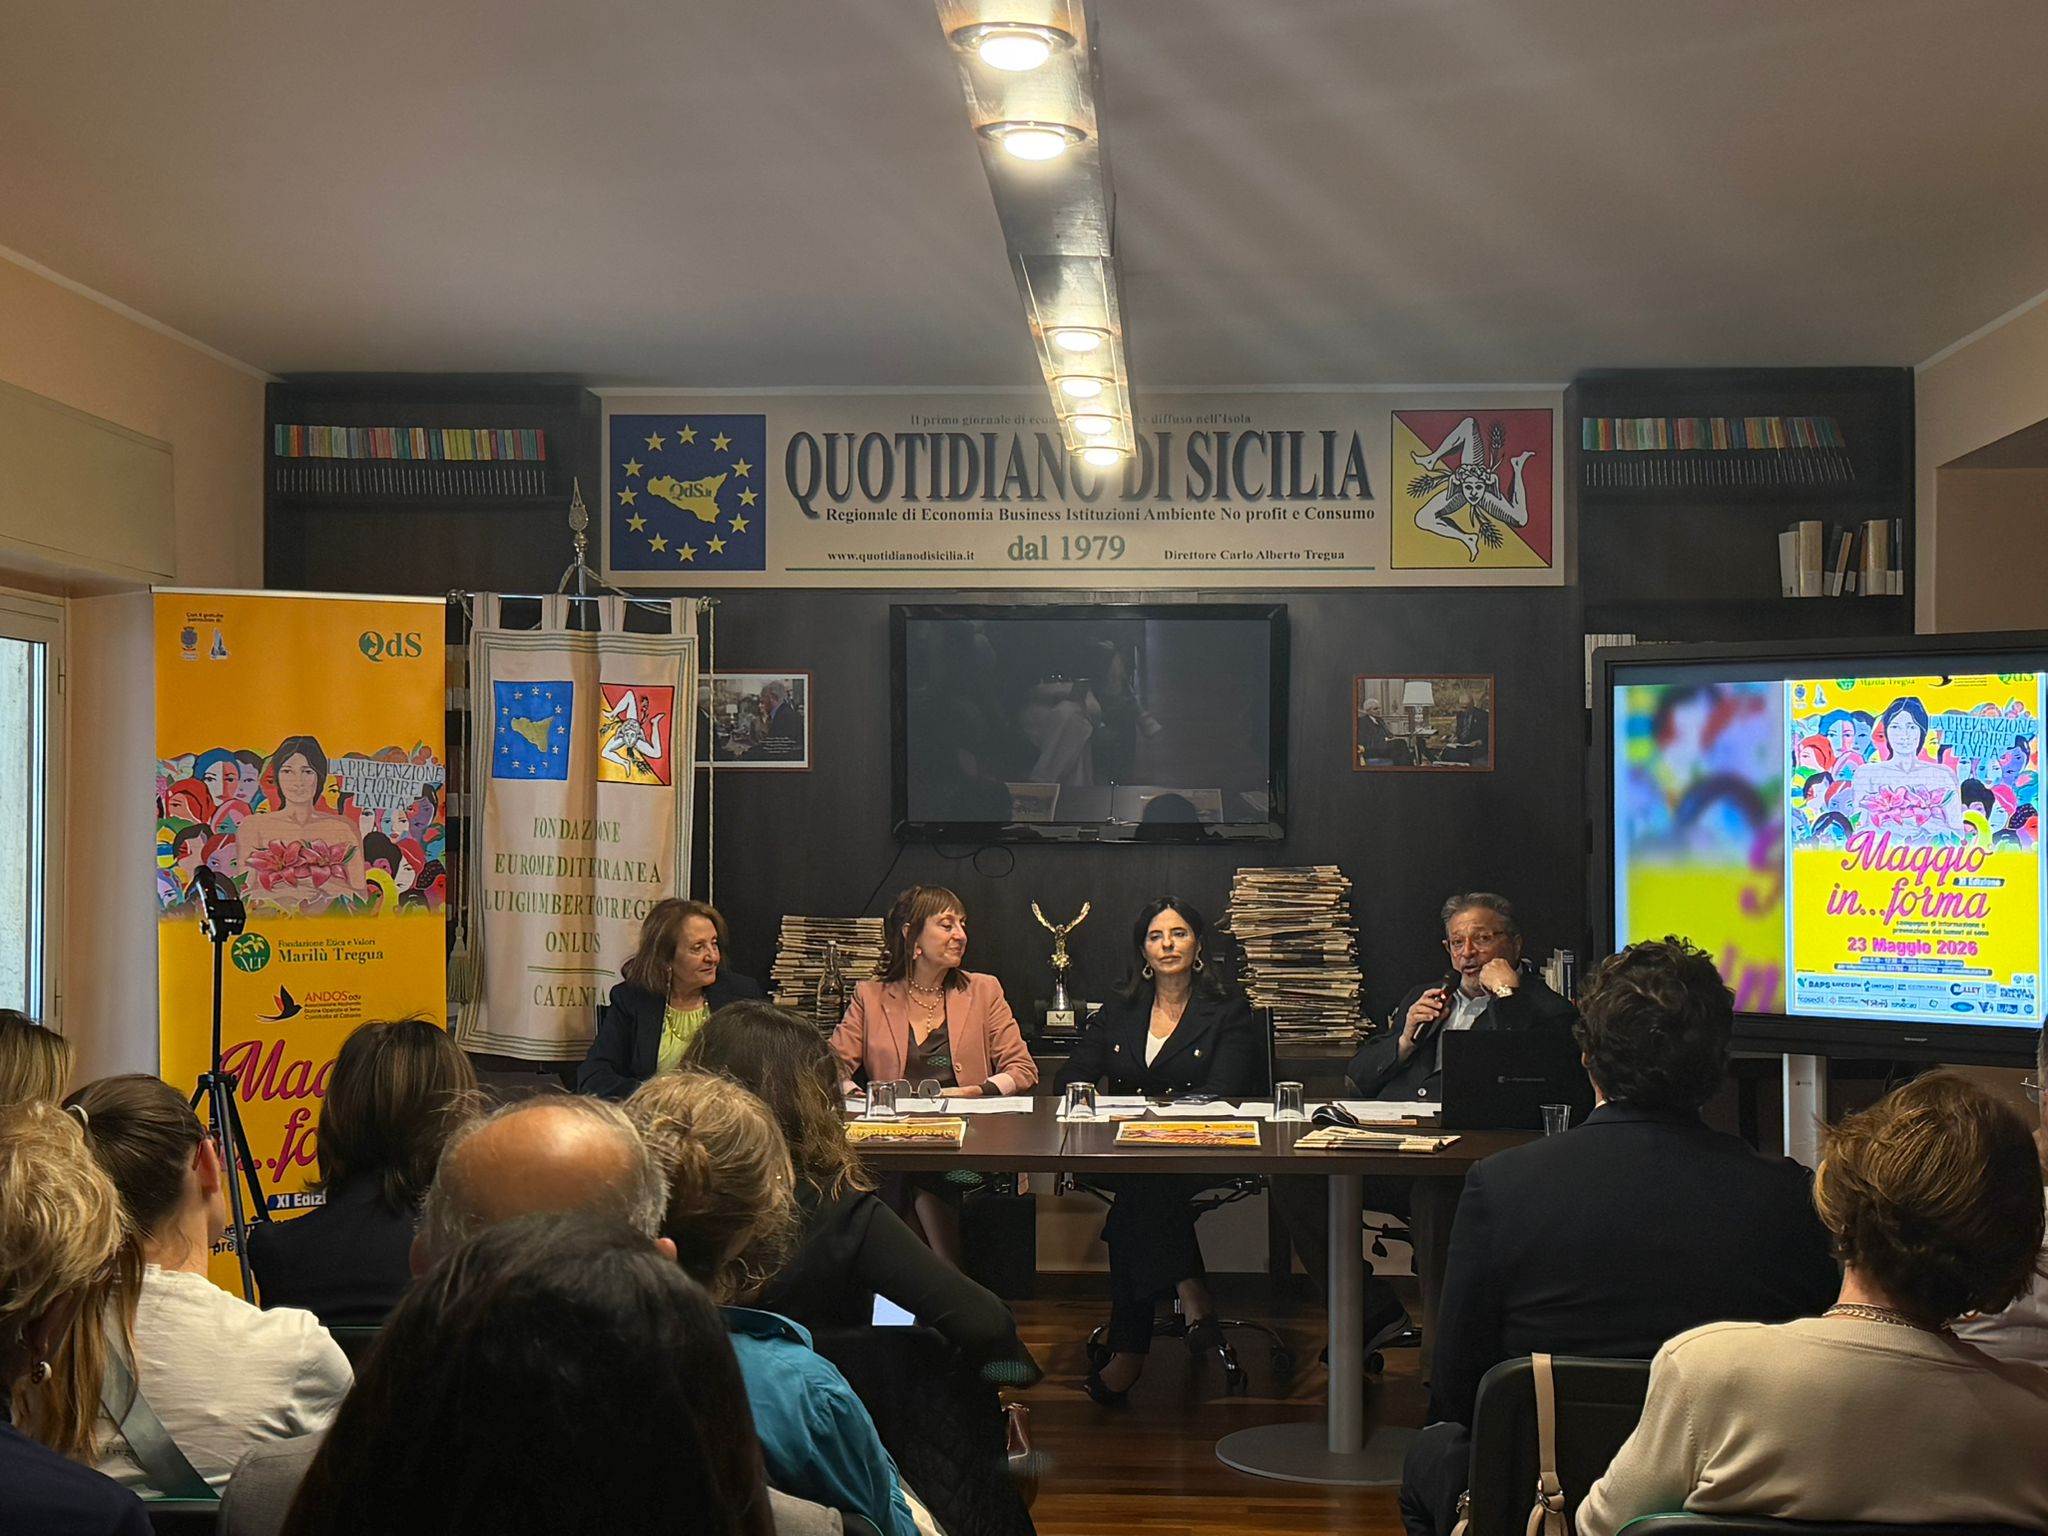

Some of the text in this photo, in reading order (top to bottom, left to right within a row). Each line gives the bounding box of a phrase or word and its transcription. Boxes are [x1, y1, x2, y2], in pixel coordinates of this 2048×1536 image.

[923, 415, 959, 427] primo
[962, 415, 1010, 426] giornale
[1014, 415, 1025, 425] di
[1152, 413, 1192, 424] diffuso
[1119, 431, 1173, 503] DI
[1186, 430, 1375, 503] SICILIA
[826, 507, 1375, 523] Regionale di Economia Business Istituzioni Ambiente No profit e Consumo
[827, 550, 974, 562] www.quotidianodisicilia.it
[1007, 535, 1126, 561] dal 1979
[1164, 550, 1345, 561] Direttore Carlo Alberto Tregua
[359, 631, 422, 662] QdS
[1947, 716, 2033, 734] PREVENZIONE
[348, 761, 443, 782] PREVENZIONE
[363, 779, 419, 796] FIORIRE
[374, 795, 405, 810] VITA
[1841, 830, 1993, 887] Maggio
[278, 939, 323, 948] Fondazione
[326, 938, 345, 946] Etica
[353, 937, 375, 946] Valori
[546, 931, 600, 953] ONLUS
[1847, 937, 1978, 957] 23 Maggio 2026
[279, 947, 383, 964] Marilù Tregua
[533, 984, 611, 1008] CATANIA
[276, 1191, 326, 1208] XI Edizi
